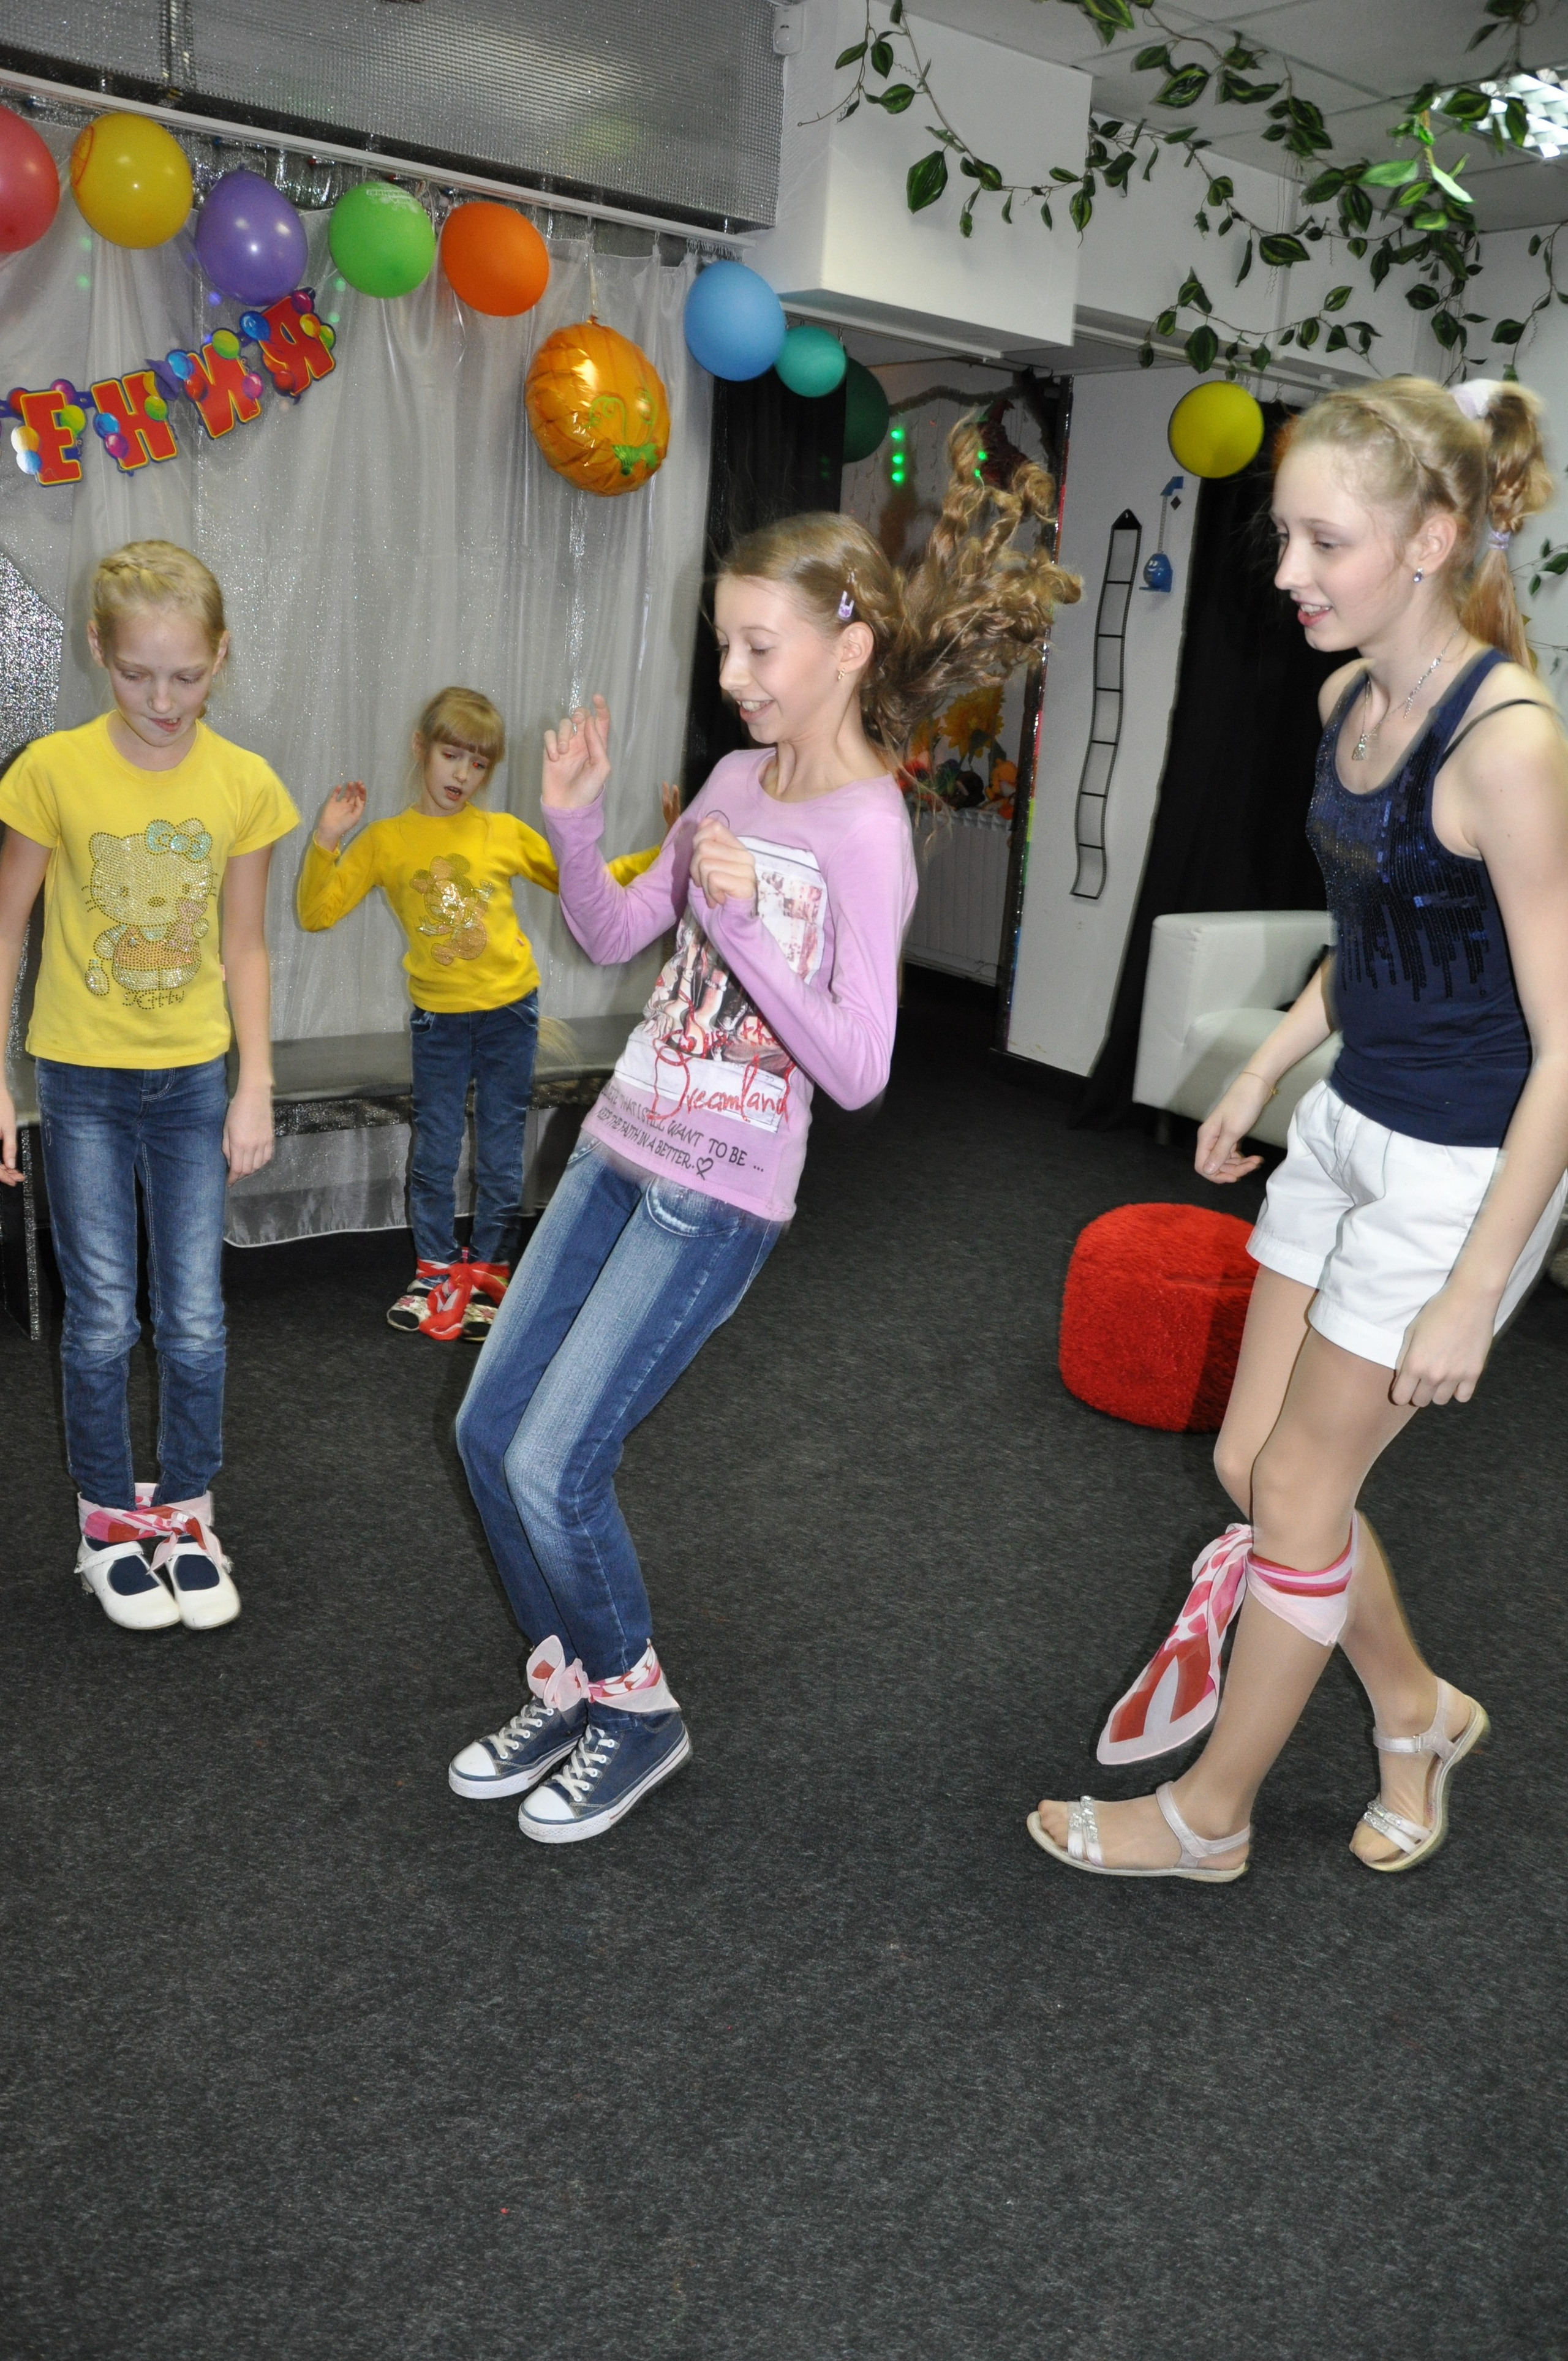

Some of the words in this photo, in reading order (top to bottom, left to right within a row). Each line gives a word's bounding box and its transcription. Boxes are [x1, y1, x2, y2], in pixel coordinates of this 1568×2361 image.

[646, 1044, 796, 1124] Dreamland
[647, 1136, 657, 1152] A
[667, 1120, 704, 1147] WANT
[709, 1138, 728, 1158] TO
[728, 1146, 748, 1166] BE
